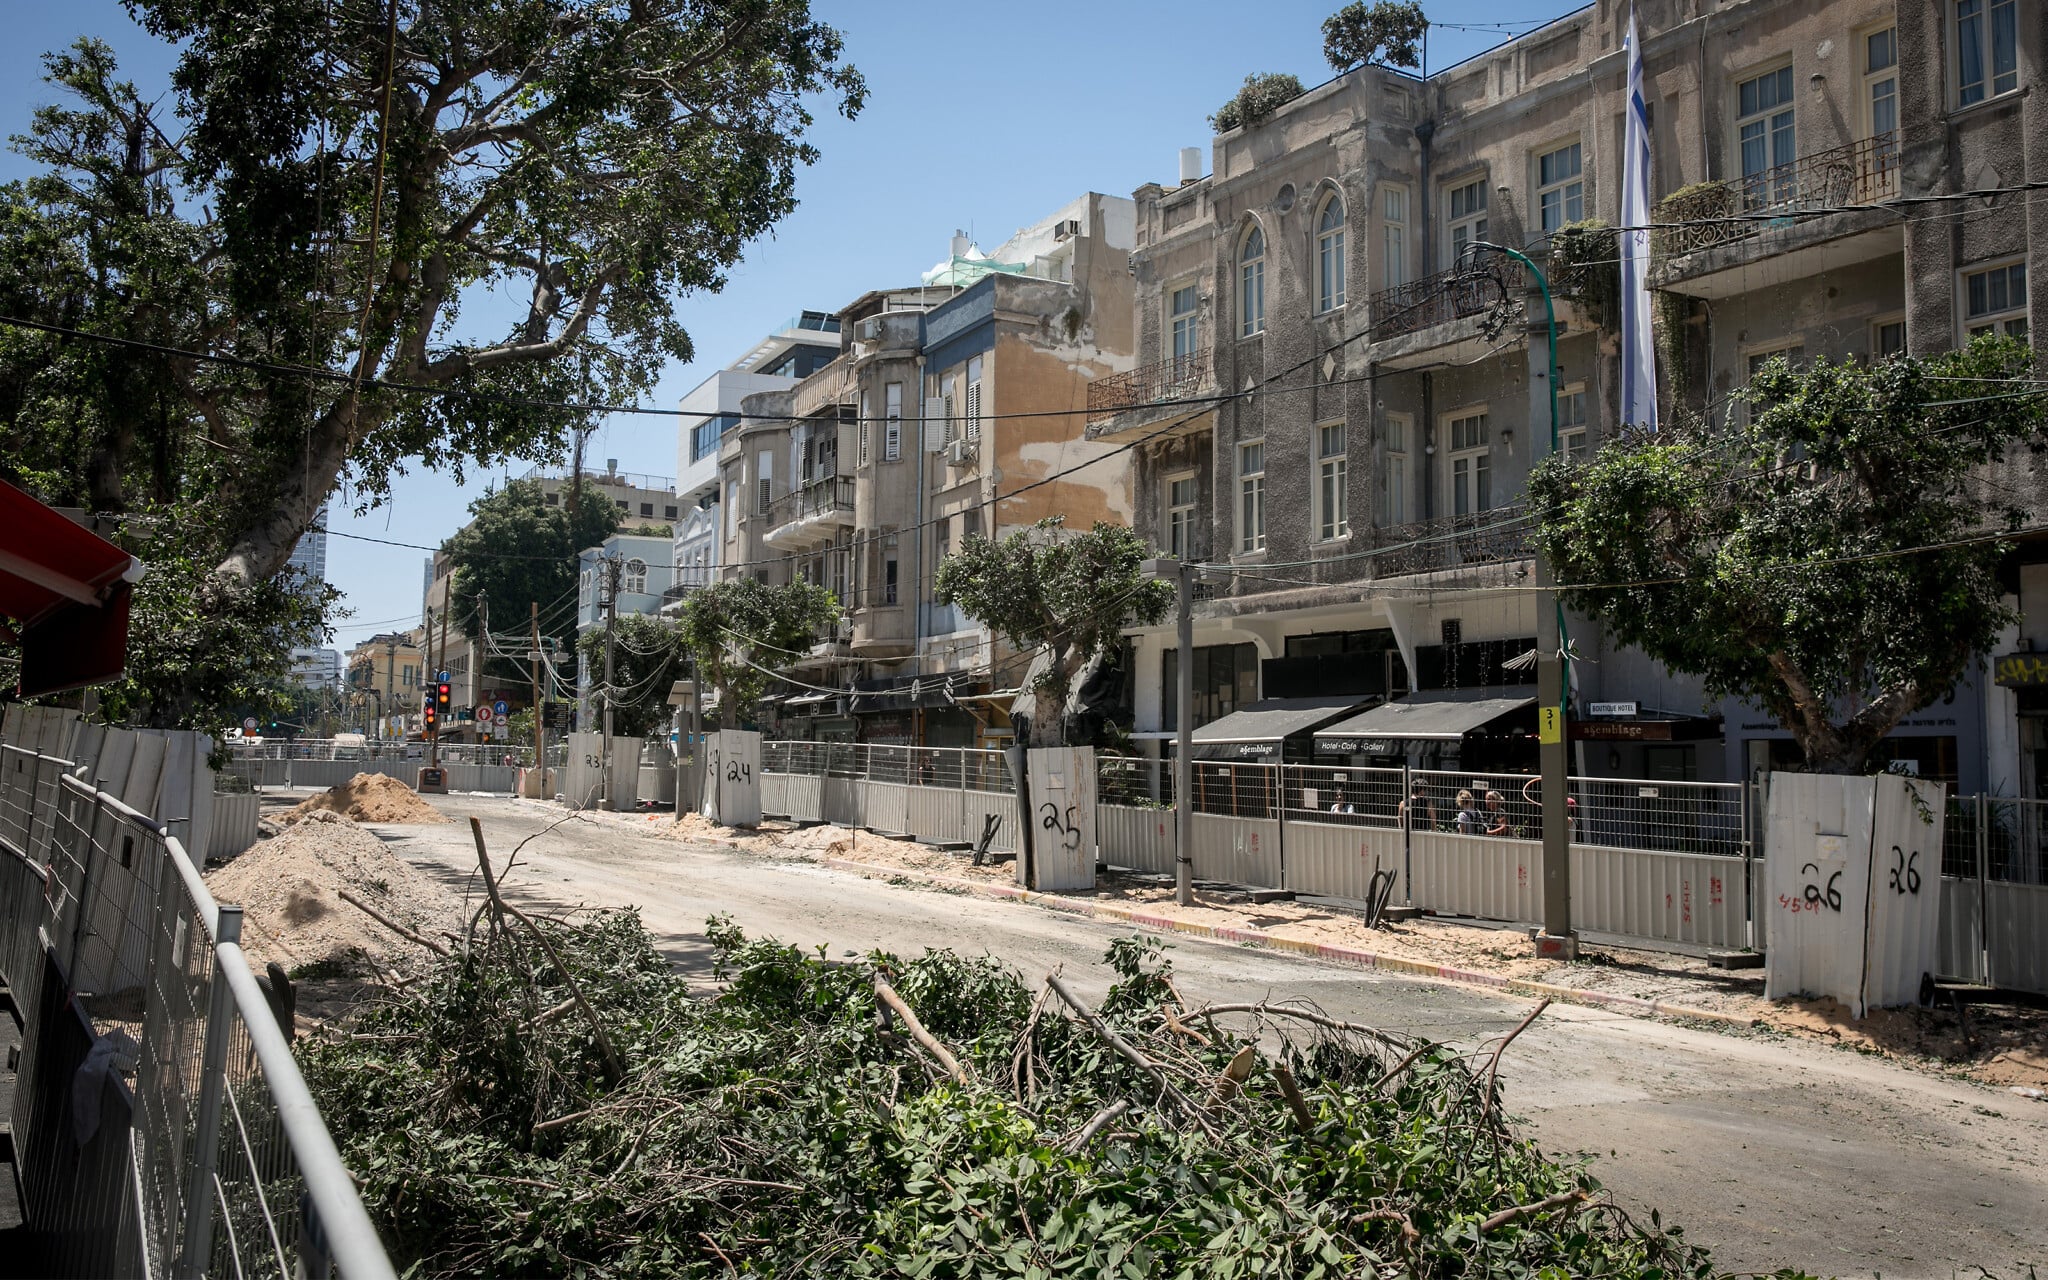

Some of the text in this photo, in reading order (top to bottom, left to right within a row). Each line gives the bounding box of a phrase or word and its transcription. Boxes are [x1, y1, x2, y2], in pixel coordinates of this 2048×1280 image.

[585, 754, 600, 768] 23
[726, 760, 751, 785] 24
[1040, 802, 1081, 850] 25
[1801, 863, 1842, 913] 26
[1889, 845, 1921, 896] 26
